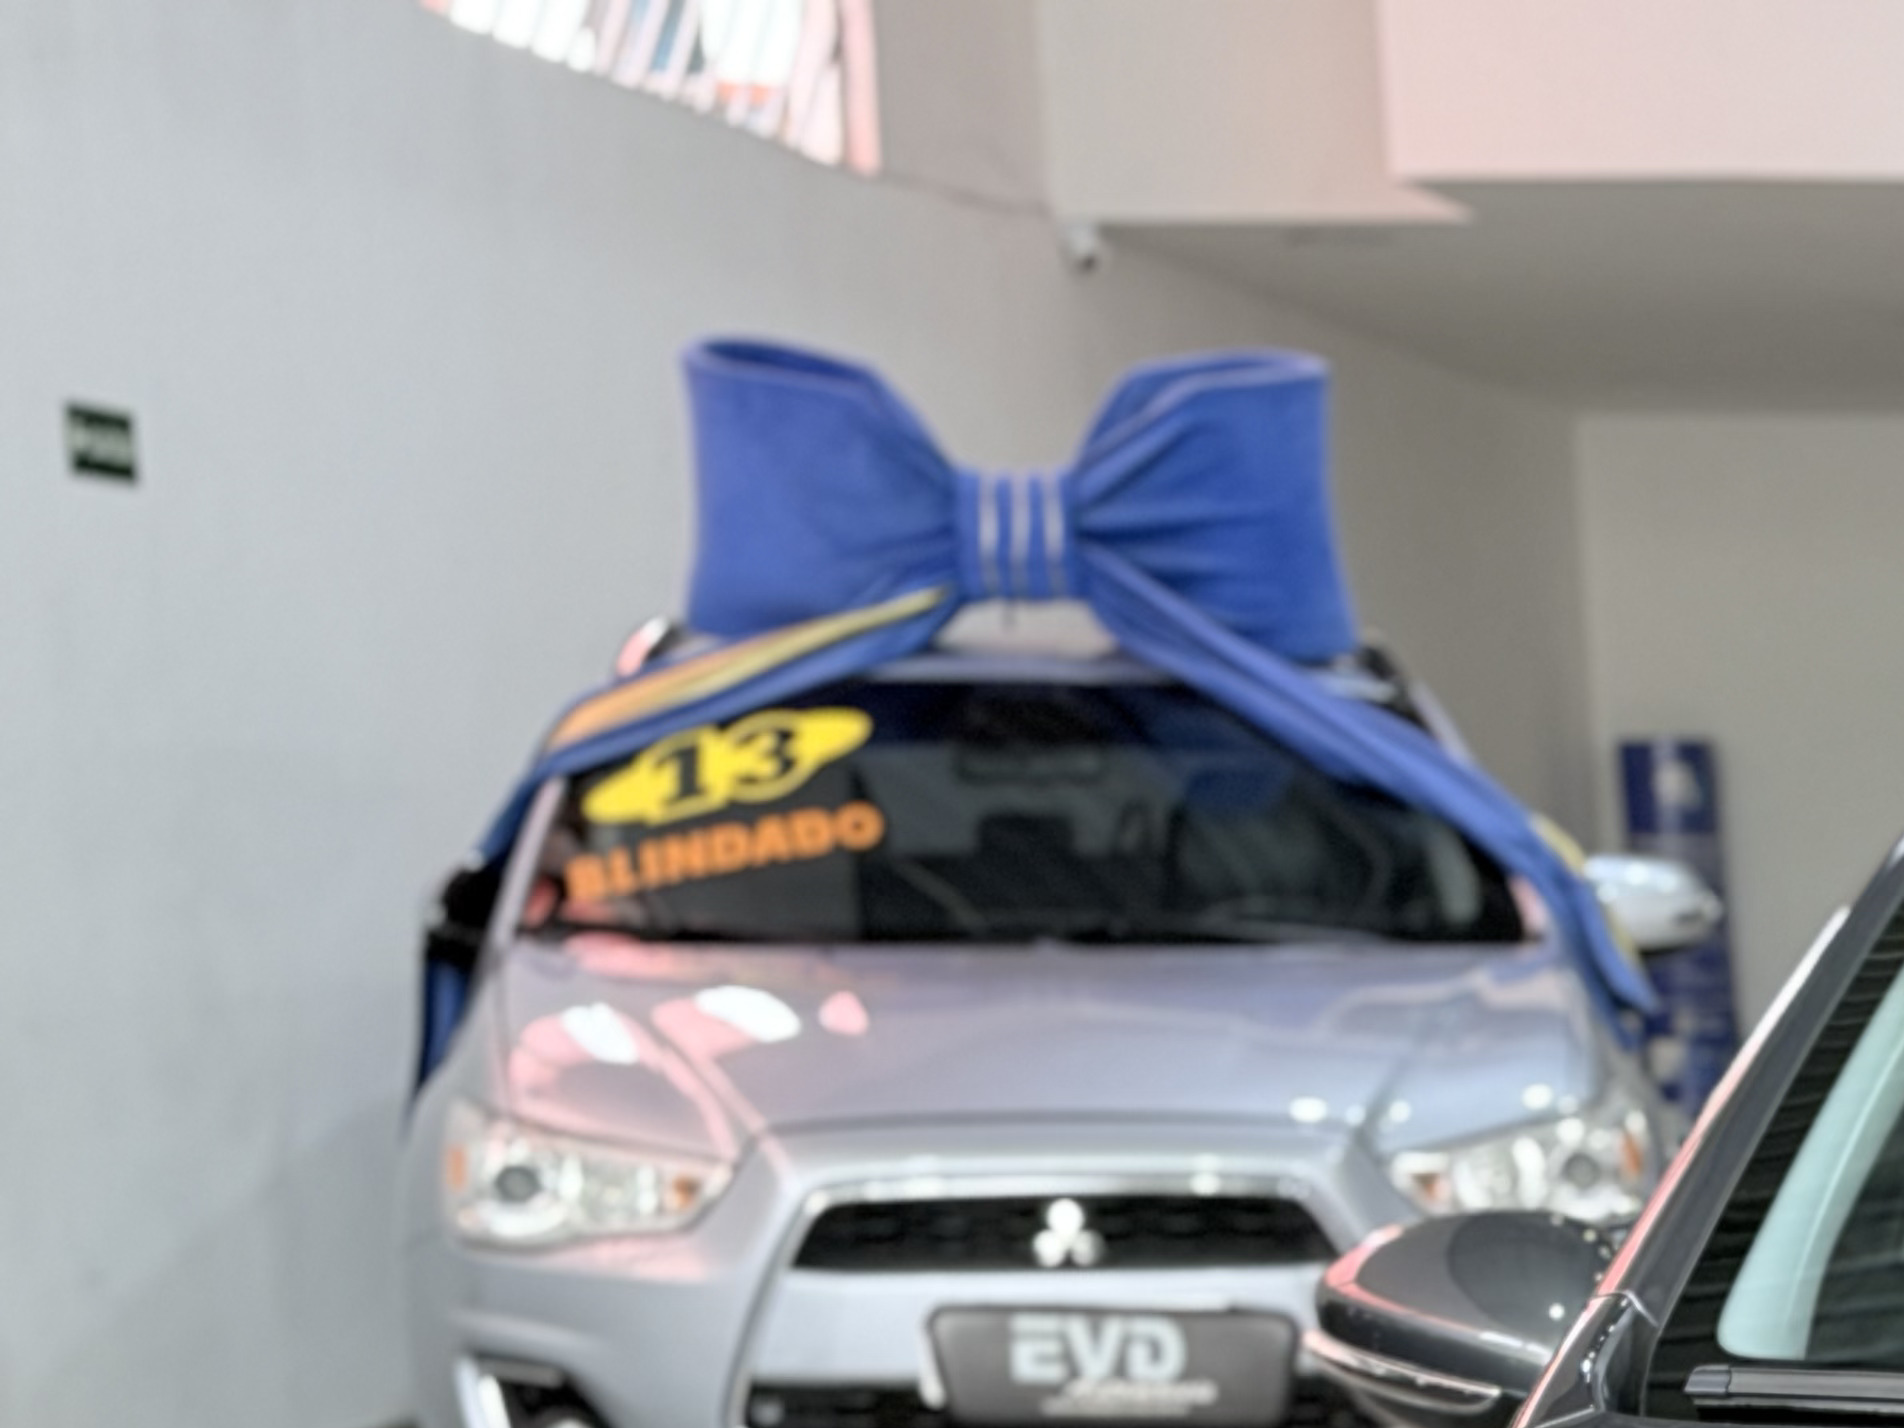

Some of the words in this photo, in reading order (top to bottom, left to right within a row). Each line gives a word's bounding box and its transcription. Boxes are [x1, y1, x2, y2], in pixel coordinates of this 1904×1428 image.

[654, 722, 799, 803] 13
[564, 803, 886, 902] BLINDADO
[1010, 1313, 1189, 1385] EVD
